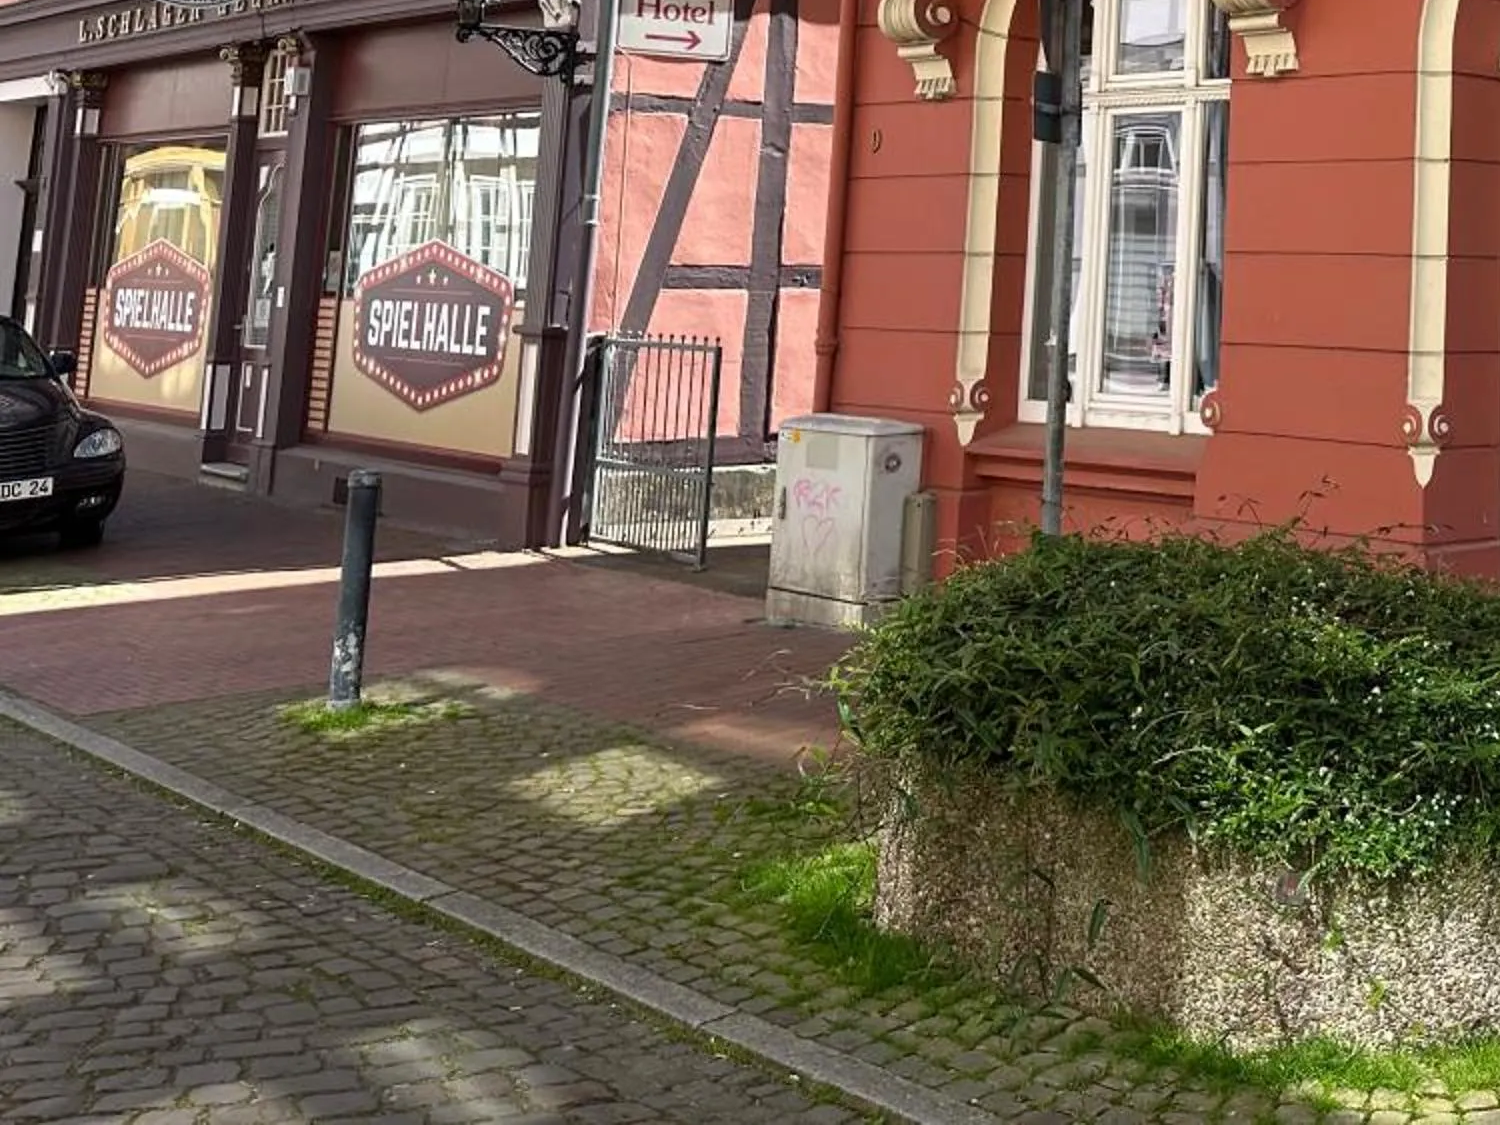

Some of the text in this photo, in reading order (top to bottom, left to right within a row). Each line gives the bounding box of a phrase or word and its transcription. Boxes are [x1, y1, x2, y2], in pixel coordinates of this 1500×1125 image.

[114, 288, 195, 332] SPIELHALLE
[367, 299, 491, 355] SPIELHALLE
[29, 479, 49, 496] 24
